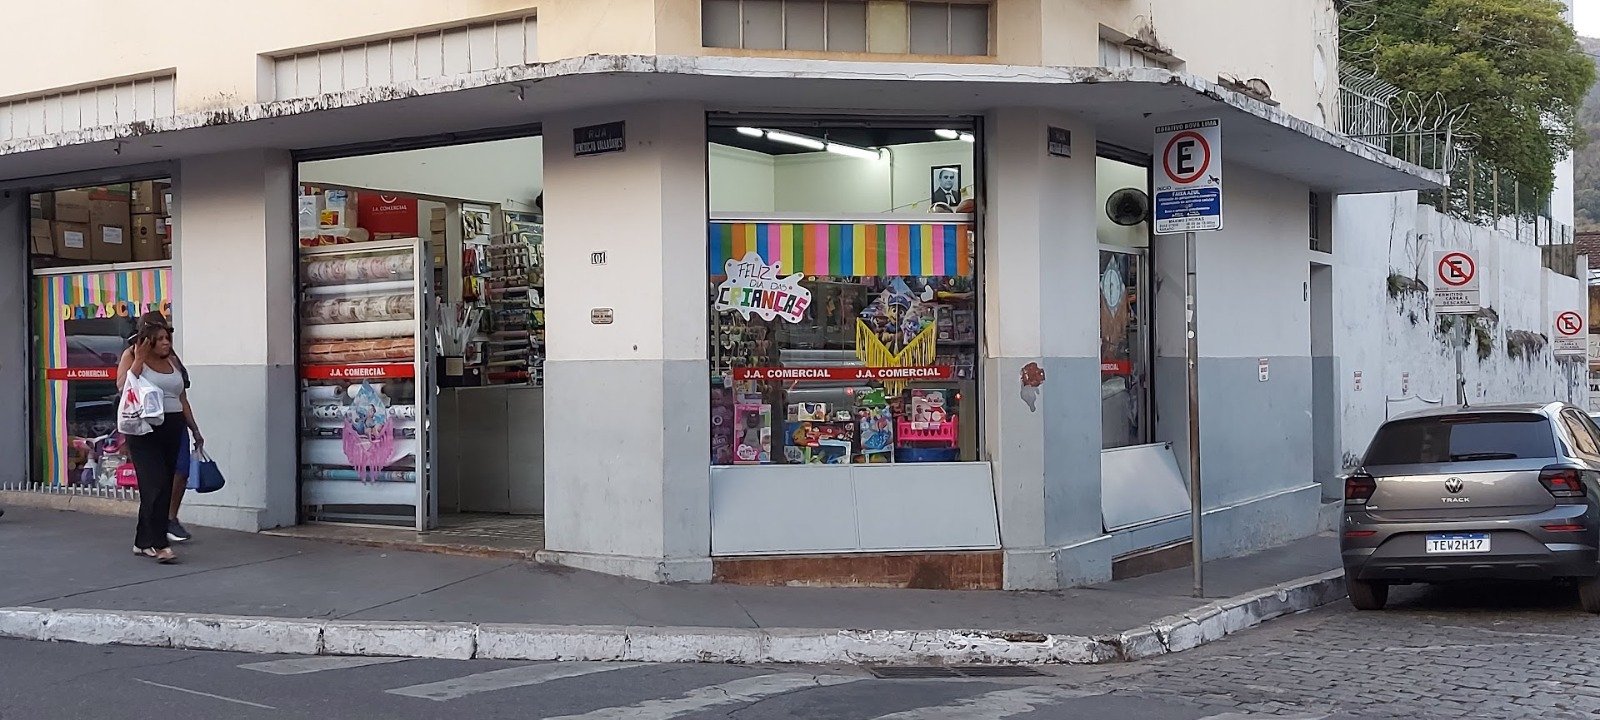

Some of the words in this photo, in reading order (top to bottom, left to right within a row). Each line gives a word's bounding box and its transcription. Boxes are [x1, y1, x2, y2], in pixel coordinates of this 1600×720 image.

[1177, 140, 1195, 174] E
[737, 262, 772, 280] FELIZ
[749, 279, 764, 288] DIA
[770, 282, 788, 290] DAS
[718, 287, 808, 317] CRIANÇAS
[62, 303, 86, 320] DIA
[87, 301, 115, 319] DAS
[78, 370, 110, 378] COMERCIAL
[329, 369, 342, 377] J.A.
[344, 367, 386, 376] COMERCIAL
[744, 369, 764, 378] J.A.
[767, 369, 831, 378] COMERCIAL
[855, 369, 875, 378] J.A.
[878, 367, 941, 377] COMERCIAL
[1433, 540, 1483, 550] TEW2H17
